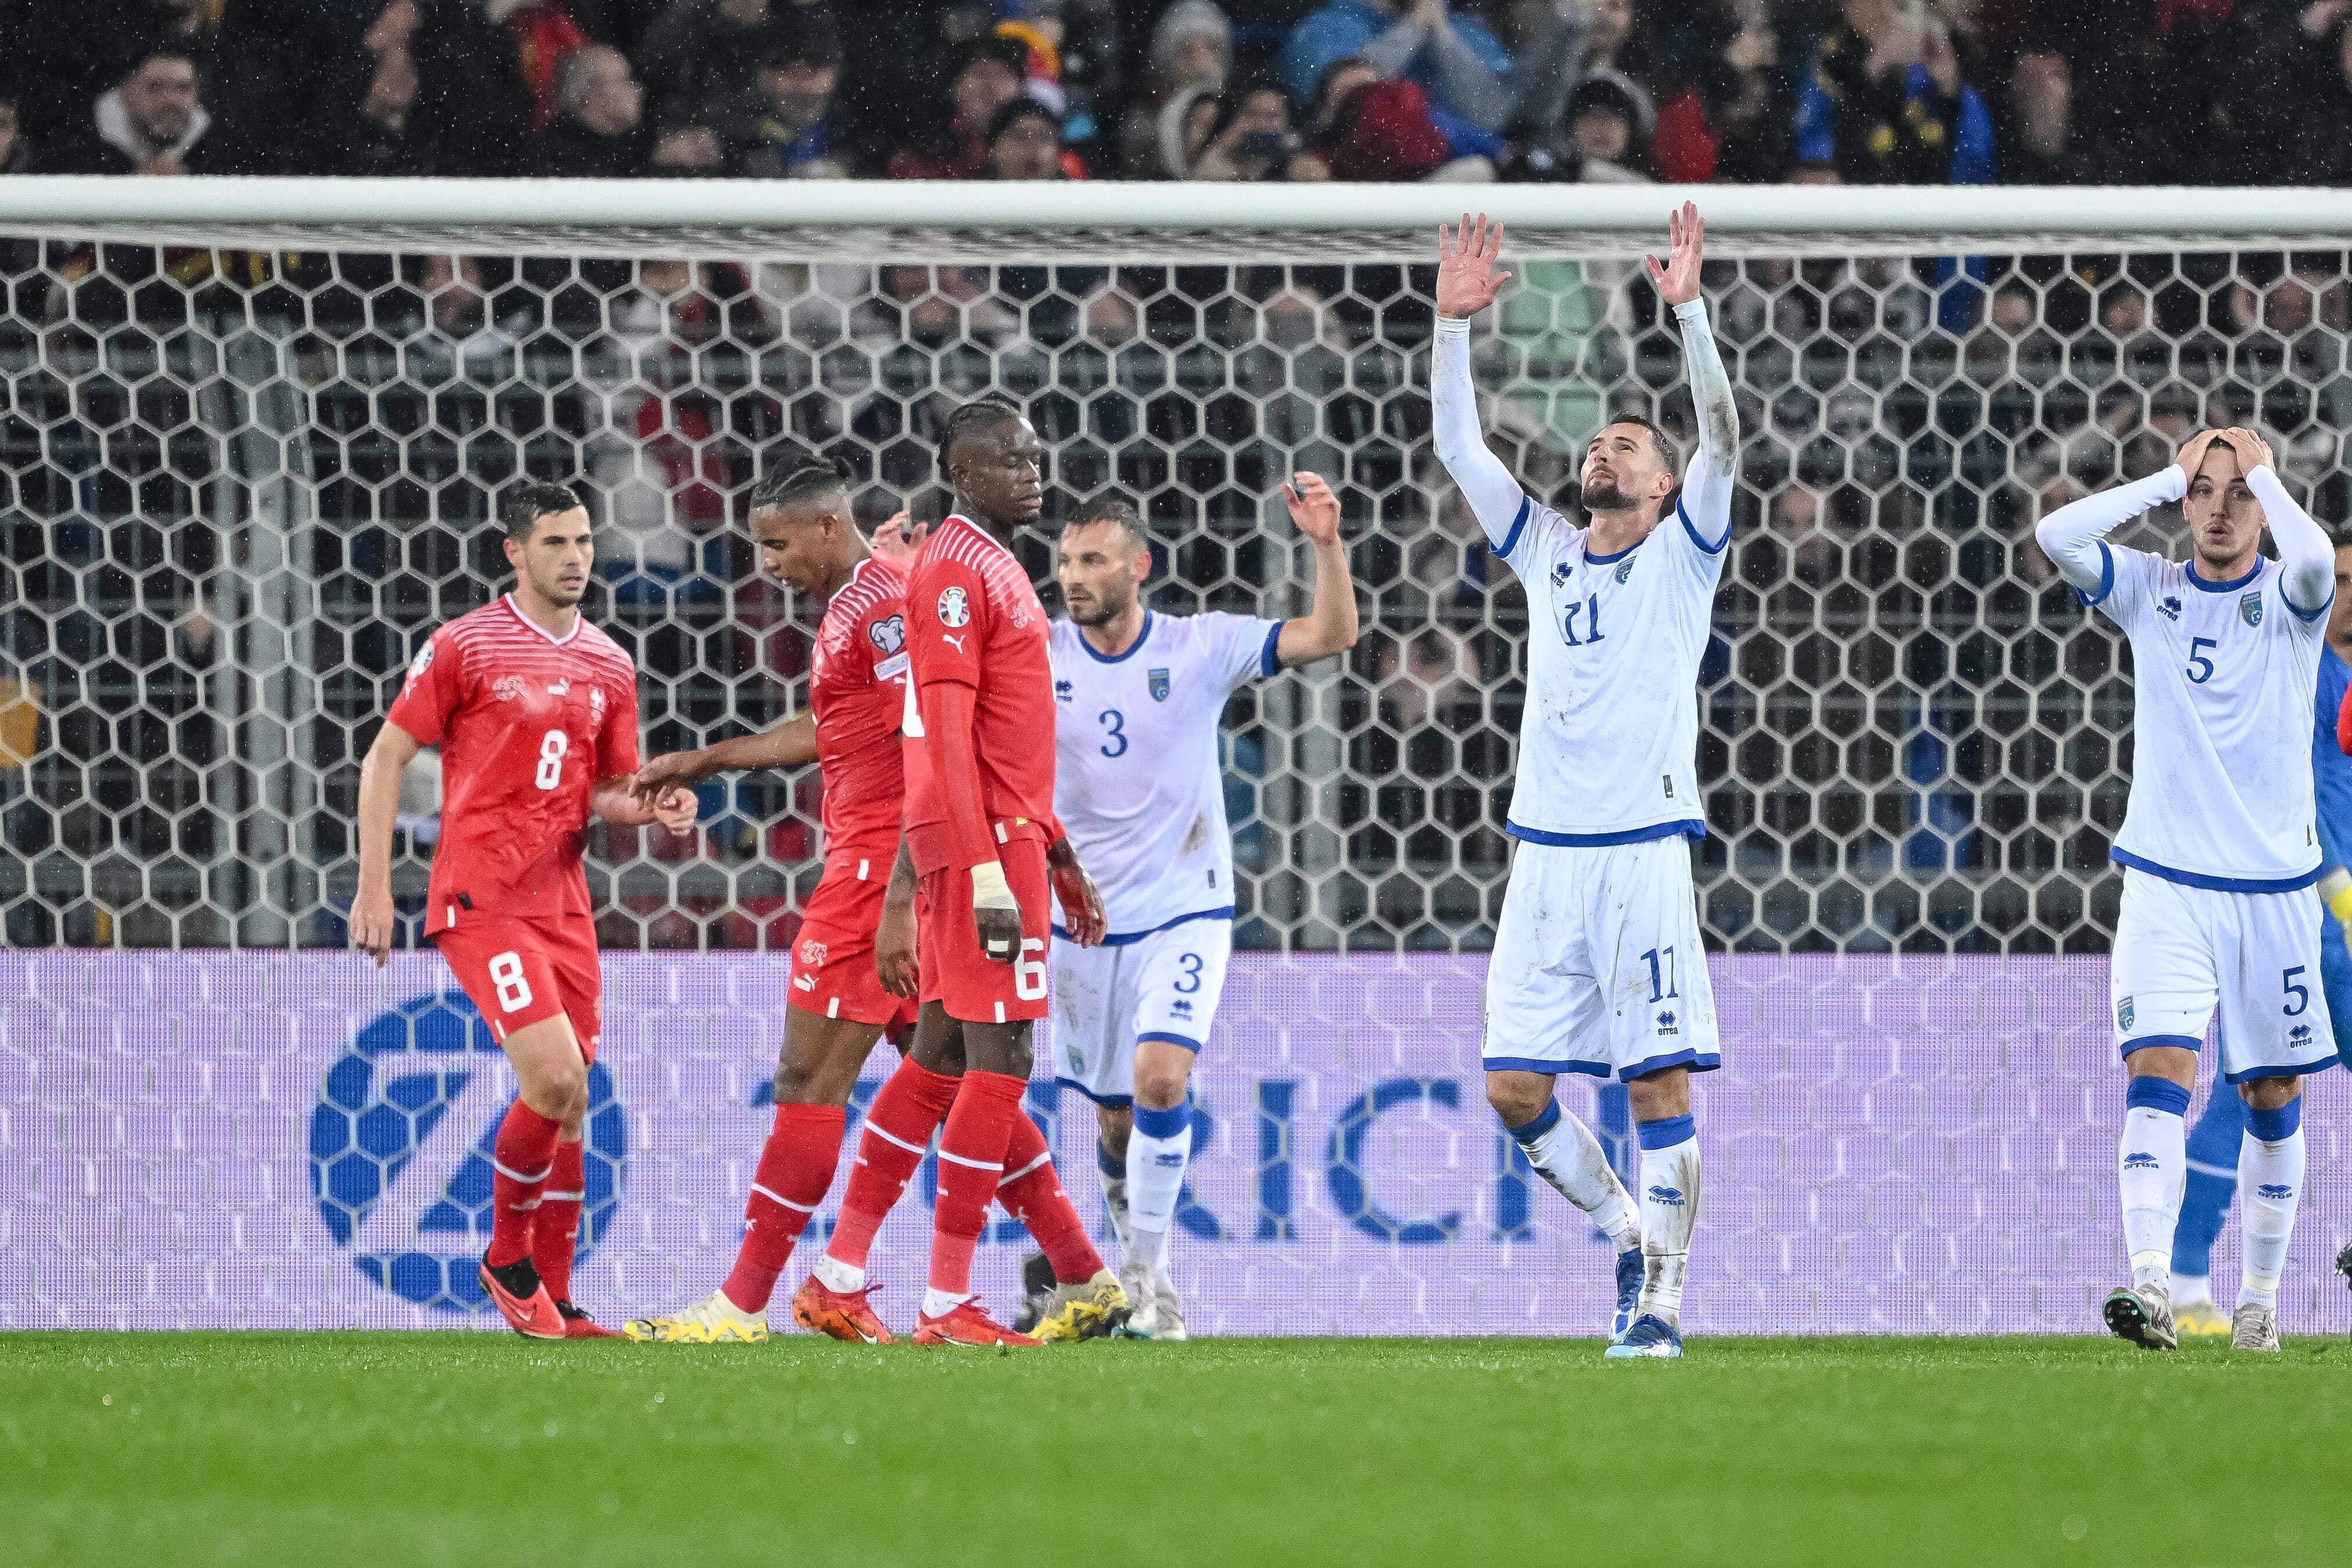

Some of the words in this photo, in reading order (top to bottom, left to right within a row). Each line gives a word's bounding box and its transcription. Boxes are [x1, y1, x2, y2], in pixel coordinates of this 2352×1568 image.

[2186, 636, 2217, 684] 5
[534, 728, 569, 790] 8
[1099, 709, 1129, 758] 3
[487, 950, 534, 1013] 8
[1014, 937, 1048, 1001] 6
[1173, 952, 1203, 993] 3
[1640, 944, 1679, 1004] 11
[2282, 965, 2309, 1016] 5
[1658, 1027, 1679, 1036] errea
[741, 1077, 1639, 1243] ICH
